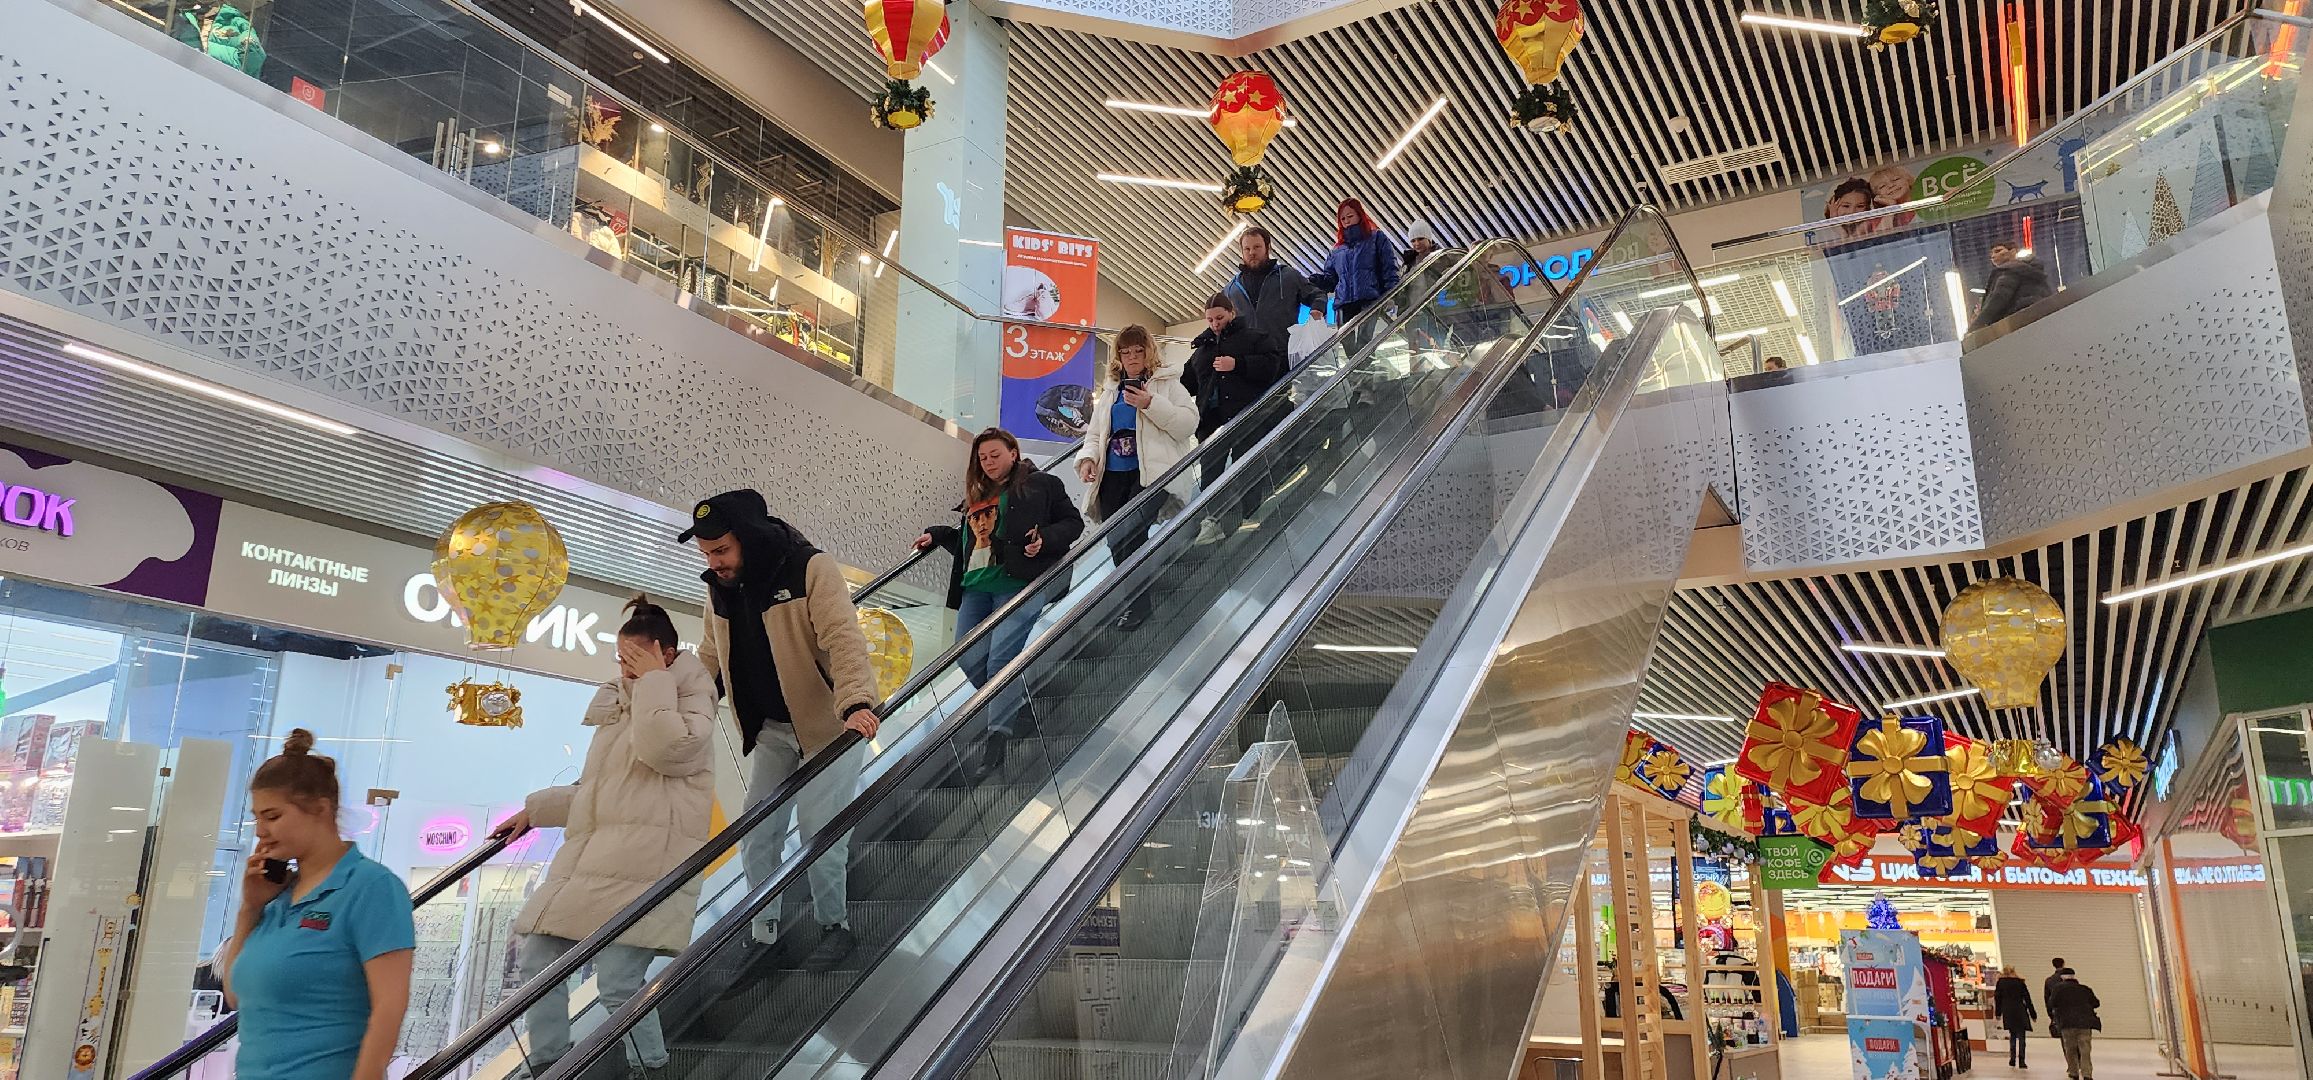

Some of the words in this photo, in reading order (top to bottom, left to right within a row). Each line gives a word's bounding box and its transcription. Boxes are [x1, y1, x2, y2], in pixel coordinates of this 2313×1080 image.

[1922, 162, 1977, 197] ВСЁ
[1012, 234, 1054, 252] KIDS'
[1057, 240, 1093, 257] BITS
[1005, 324, 1029, 358] 3
[1029, 348, 1065, 362] ЭТАЖ
[241, 541, 369, 583] КОНТАКТНЫЕ
[268, 568, 339, 597] ЛИНЗЫ
[426, 831, 458, 846] MOSCHINO
[1765, 844, 1799, 857] ТВОЙ
[1767, 858, 1802, 868] КОФЕ
[1768, 869, 1809, 881] ЗДЕСЬ
[2004, 866, 2088, 885] БЫТОВАЯ
[1852, 970, 1895, 987] ПОДАРИ
